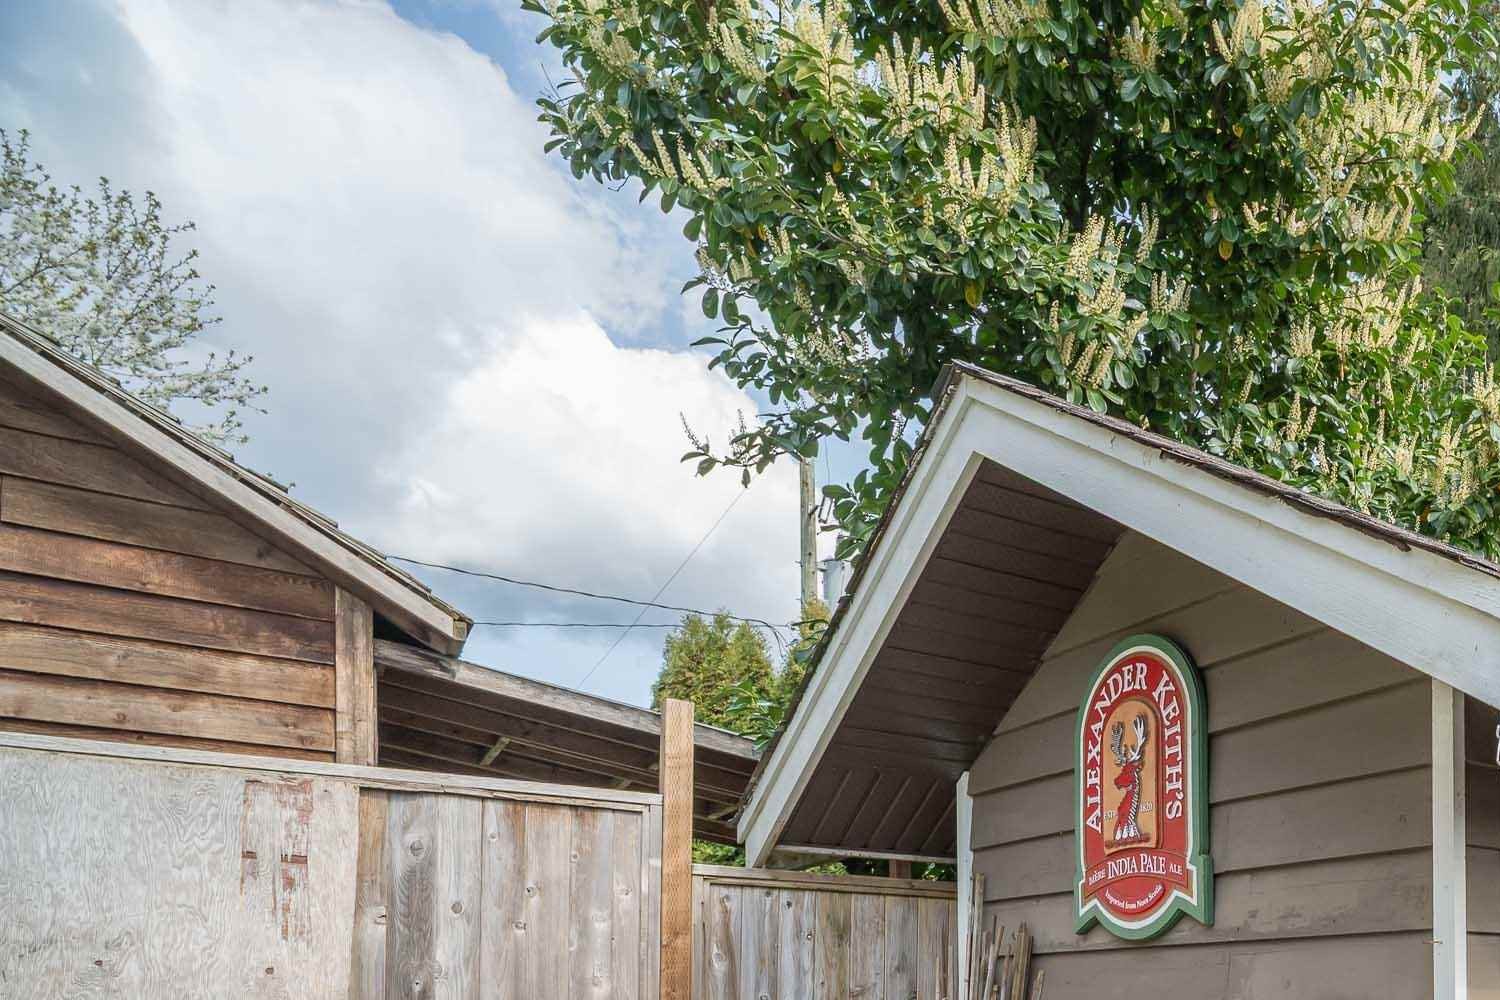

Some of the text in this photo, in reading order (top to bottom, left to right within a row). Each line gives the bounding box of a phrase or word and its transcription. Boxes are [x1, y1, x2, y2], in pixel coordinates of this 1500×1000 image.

[1086, 661, 1184, 834] ALEXANDER KEITH'S
[1107, 855, 1138, 879] INDIA
[1140, 853, 1167, 874] PALE
[1169, 863, 1183, 876] ALE
